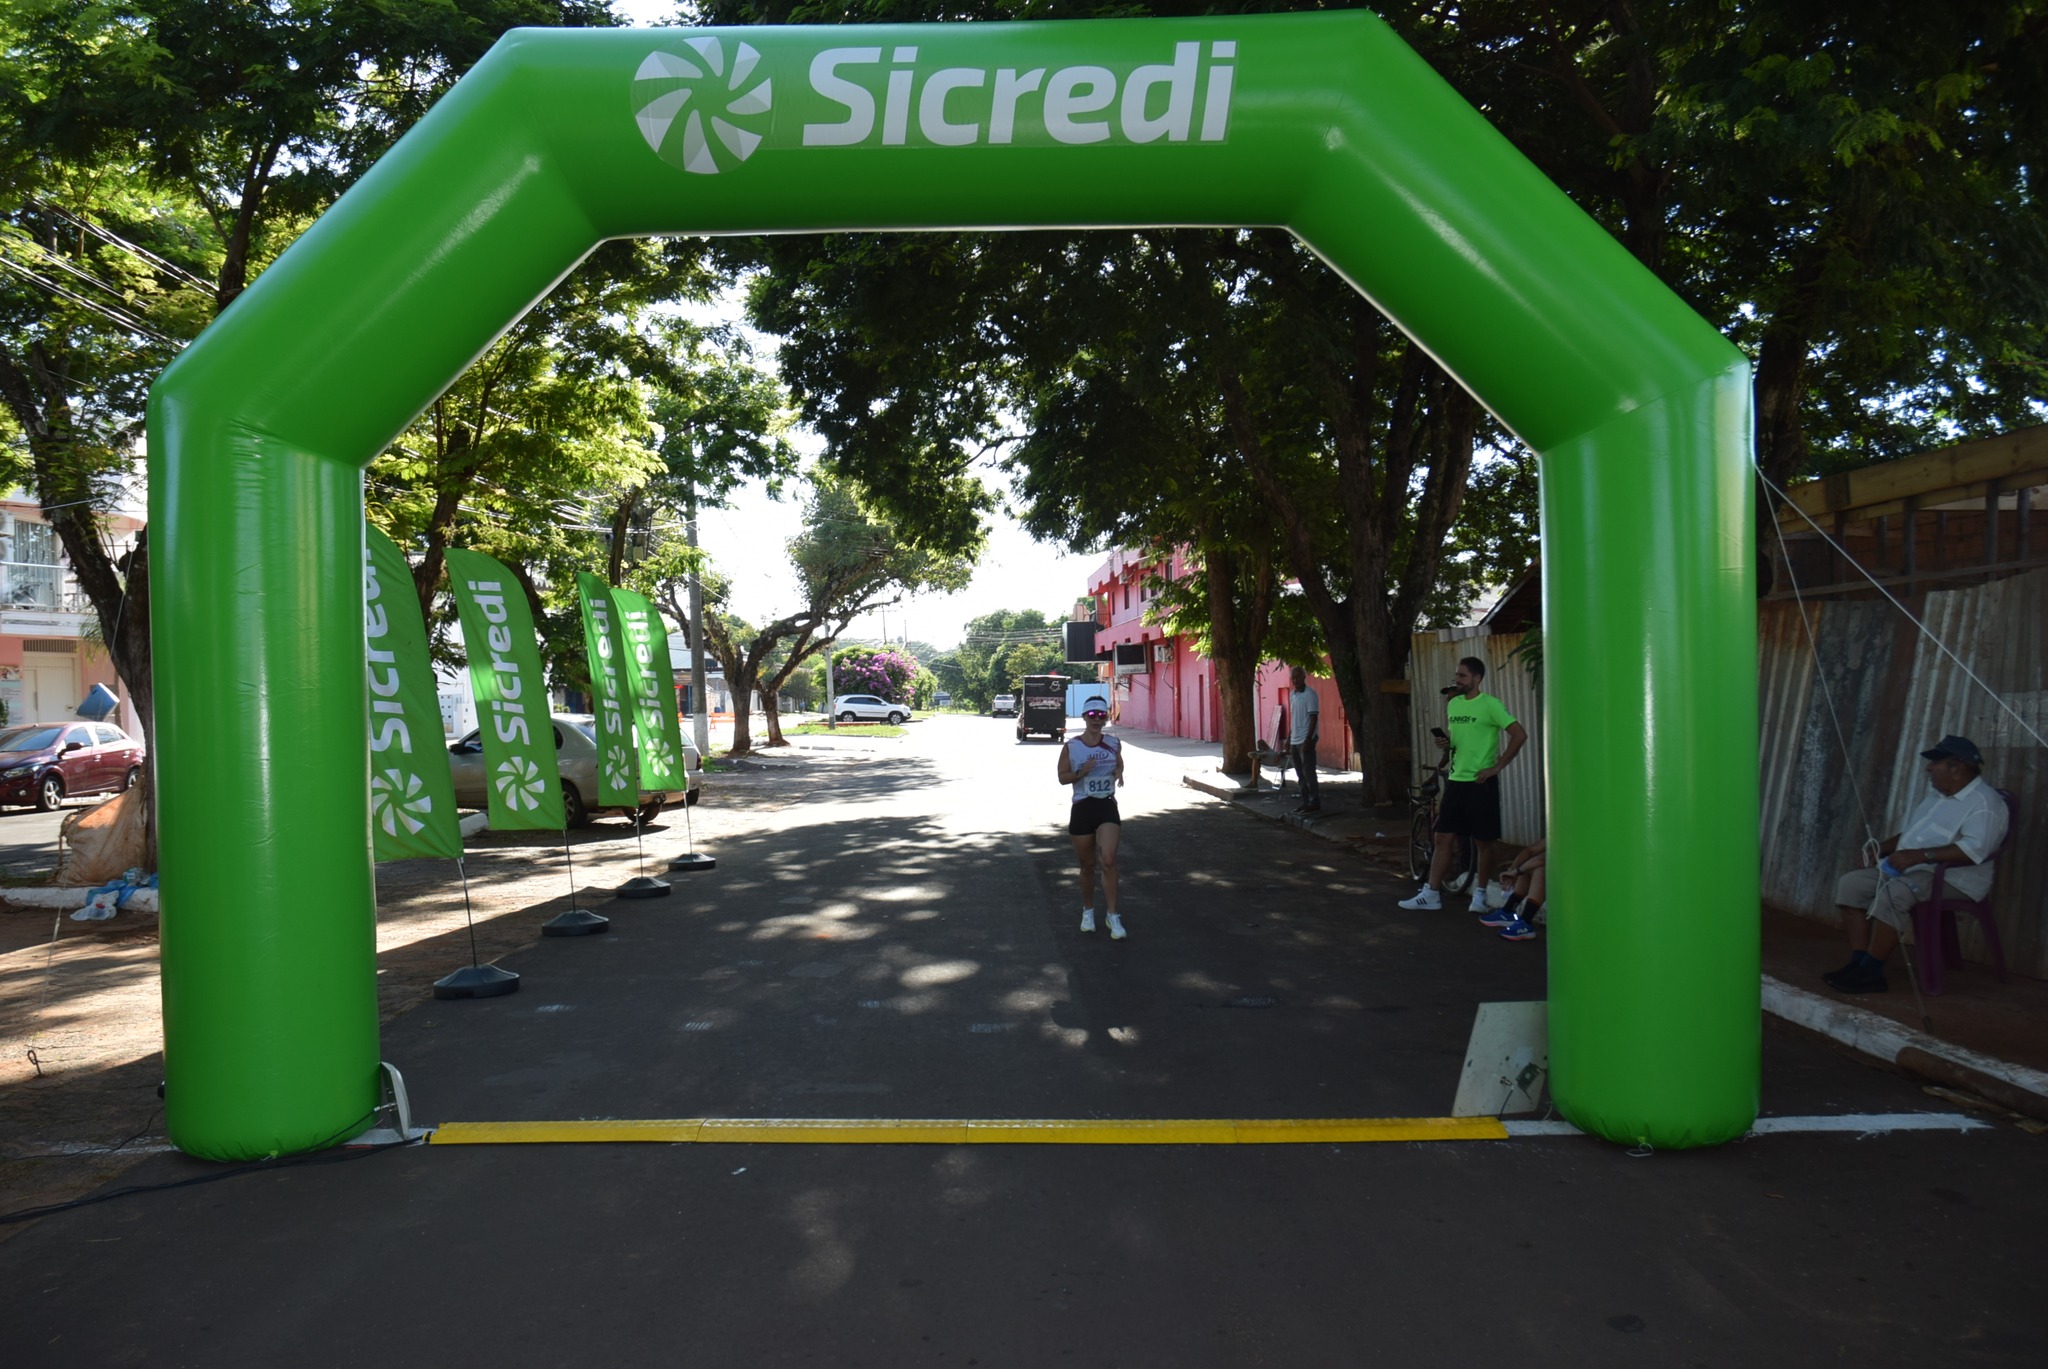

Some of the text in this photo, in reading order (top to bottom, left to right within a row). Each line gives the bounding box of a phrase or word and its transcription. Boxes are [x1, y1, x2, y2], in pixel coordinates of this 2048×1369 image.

[801, 40, 1237, 147] Sicredi
[366, 549, 412, 754] Sicre
[468, 580, 531, 746] Sicredi
[589, 598, 623, 736] Sicredi
[625, 610, 665, 731] Sicredi
[1088, 779, 1111, 793] 812
